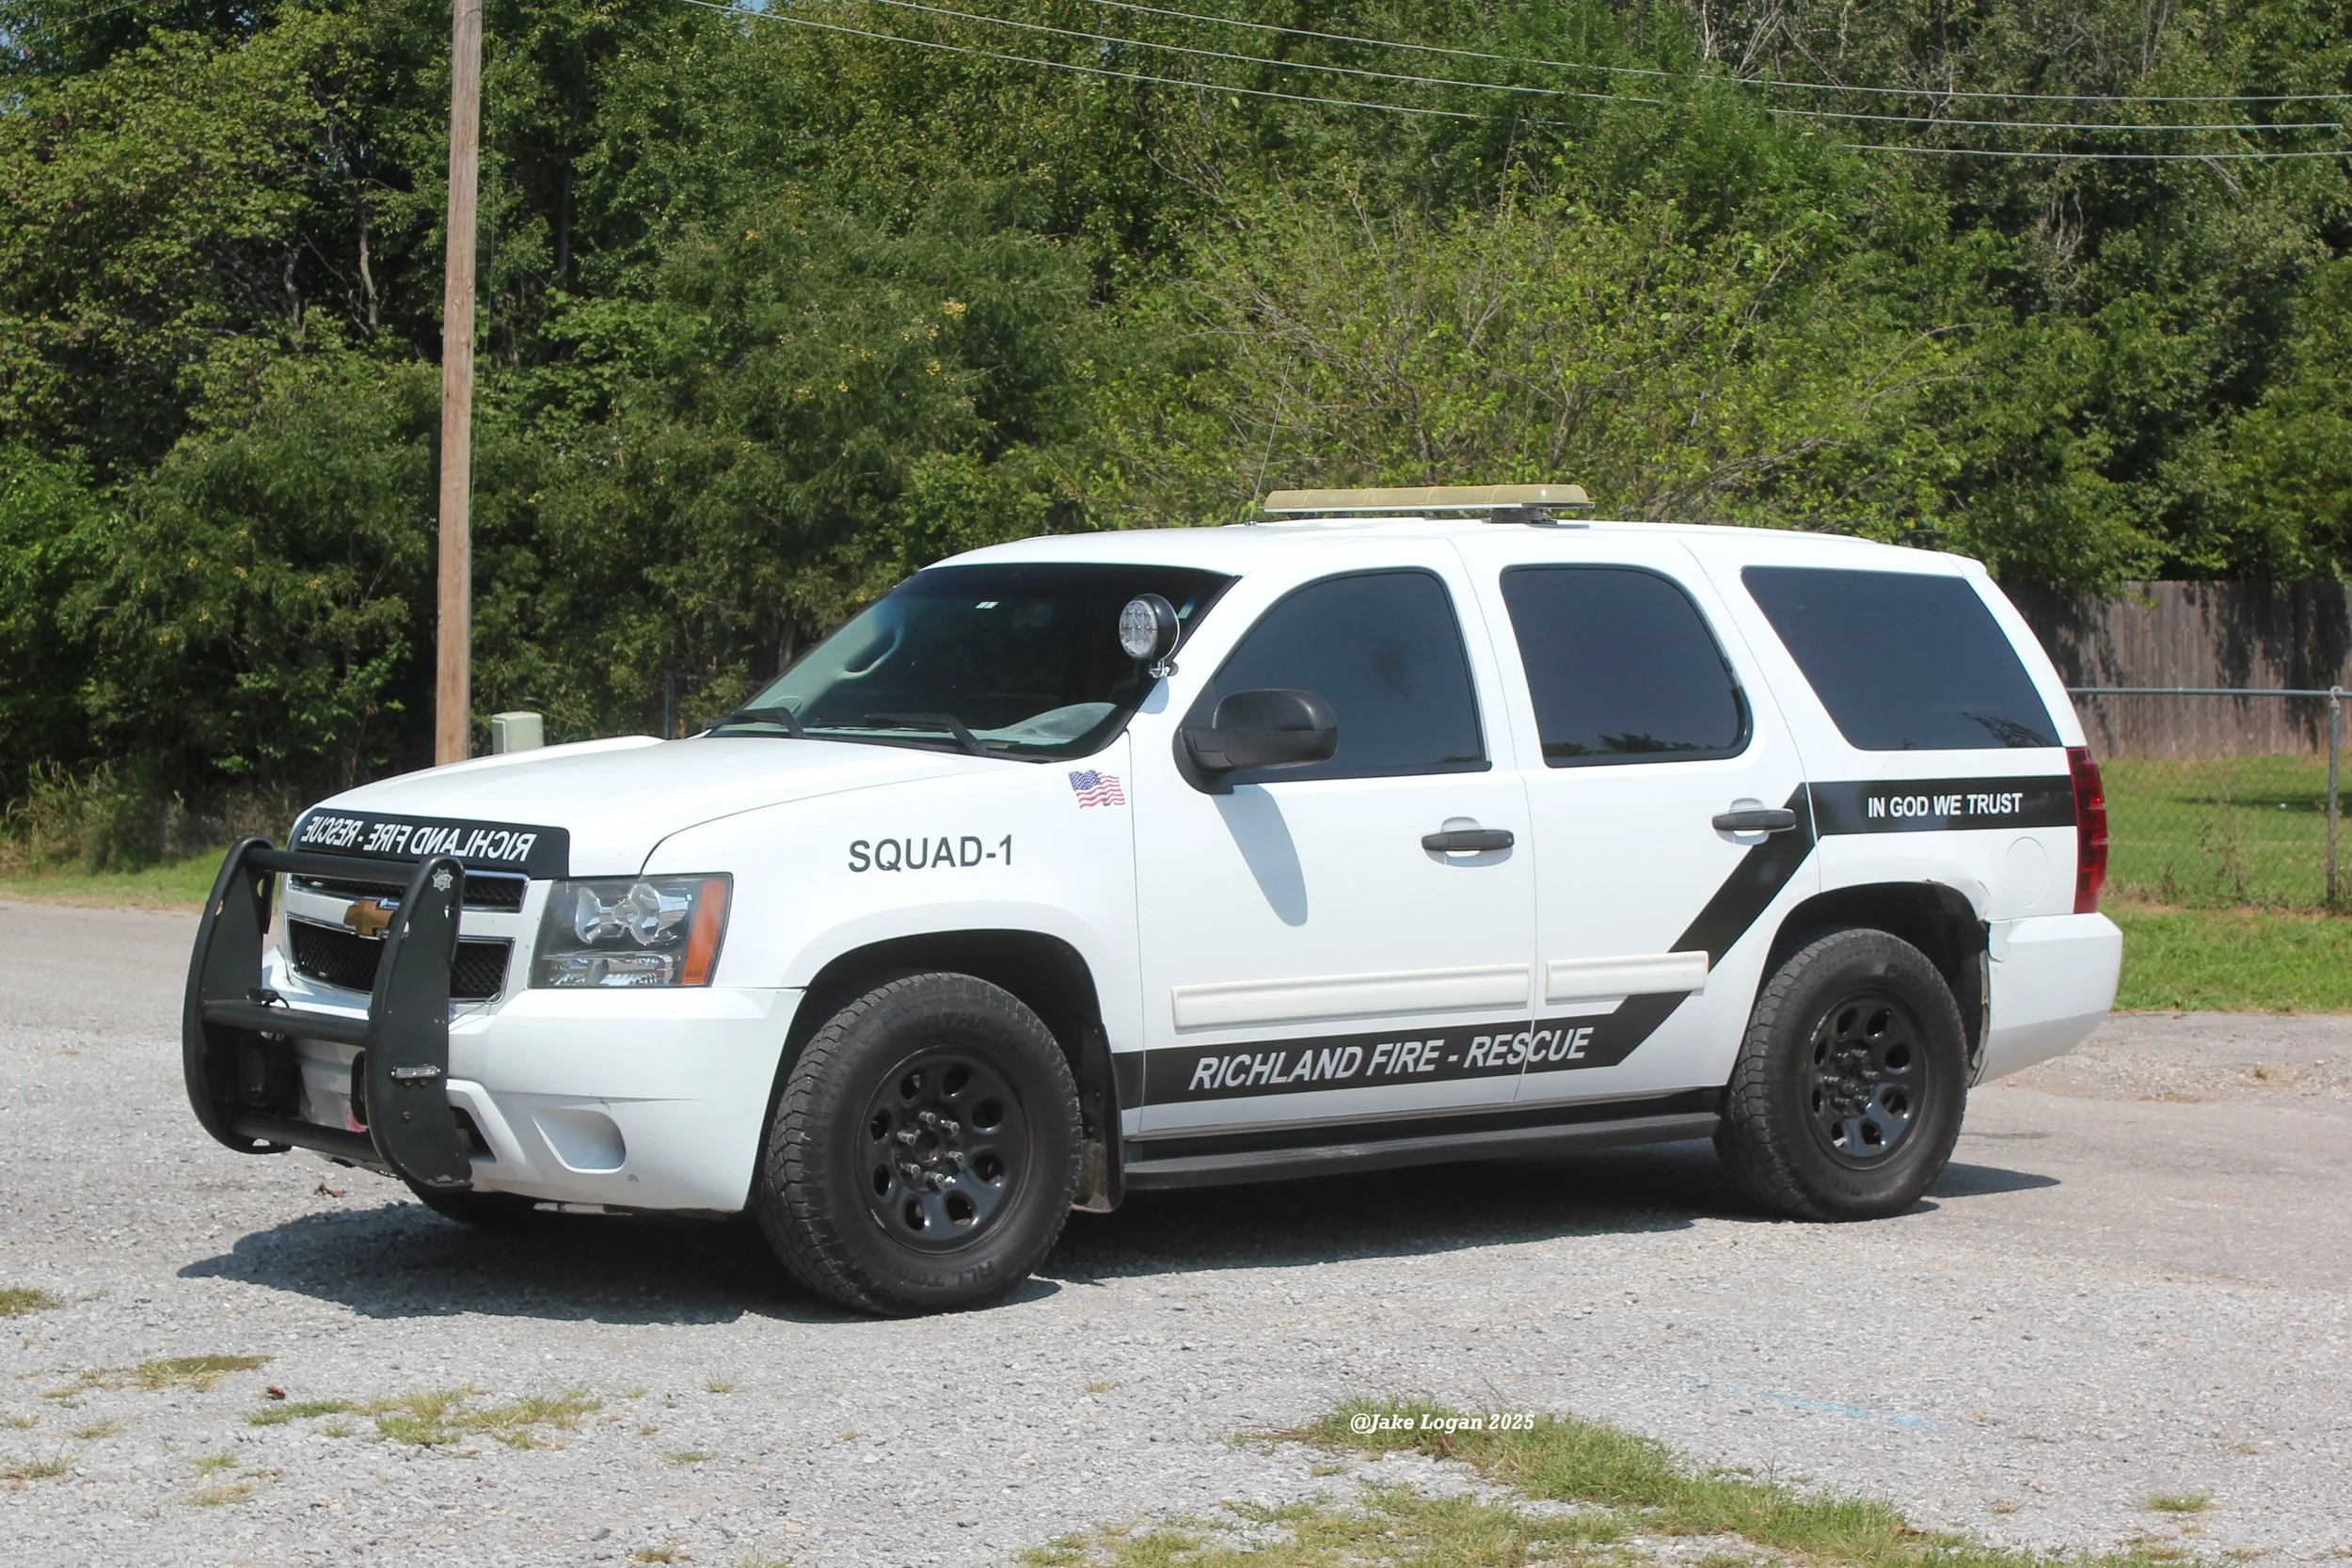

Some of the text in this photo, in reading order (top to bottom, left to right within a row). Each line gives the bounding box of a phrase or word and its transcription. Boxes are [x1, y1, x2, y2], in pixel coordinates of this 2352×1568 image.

[1867, 792, 2023, 818] IN GOD WE TRUST
[848, 834, 1013, 873] SQUAD-1
[1188, 1045, 1363, 1091] RICHLAND
[1366, 1038, 1444, 1077] FIRE
[1463, 1026, 1595, 1069] RESCUE
